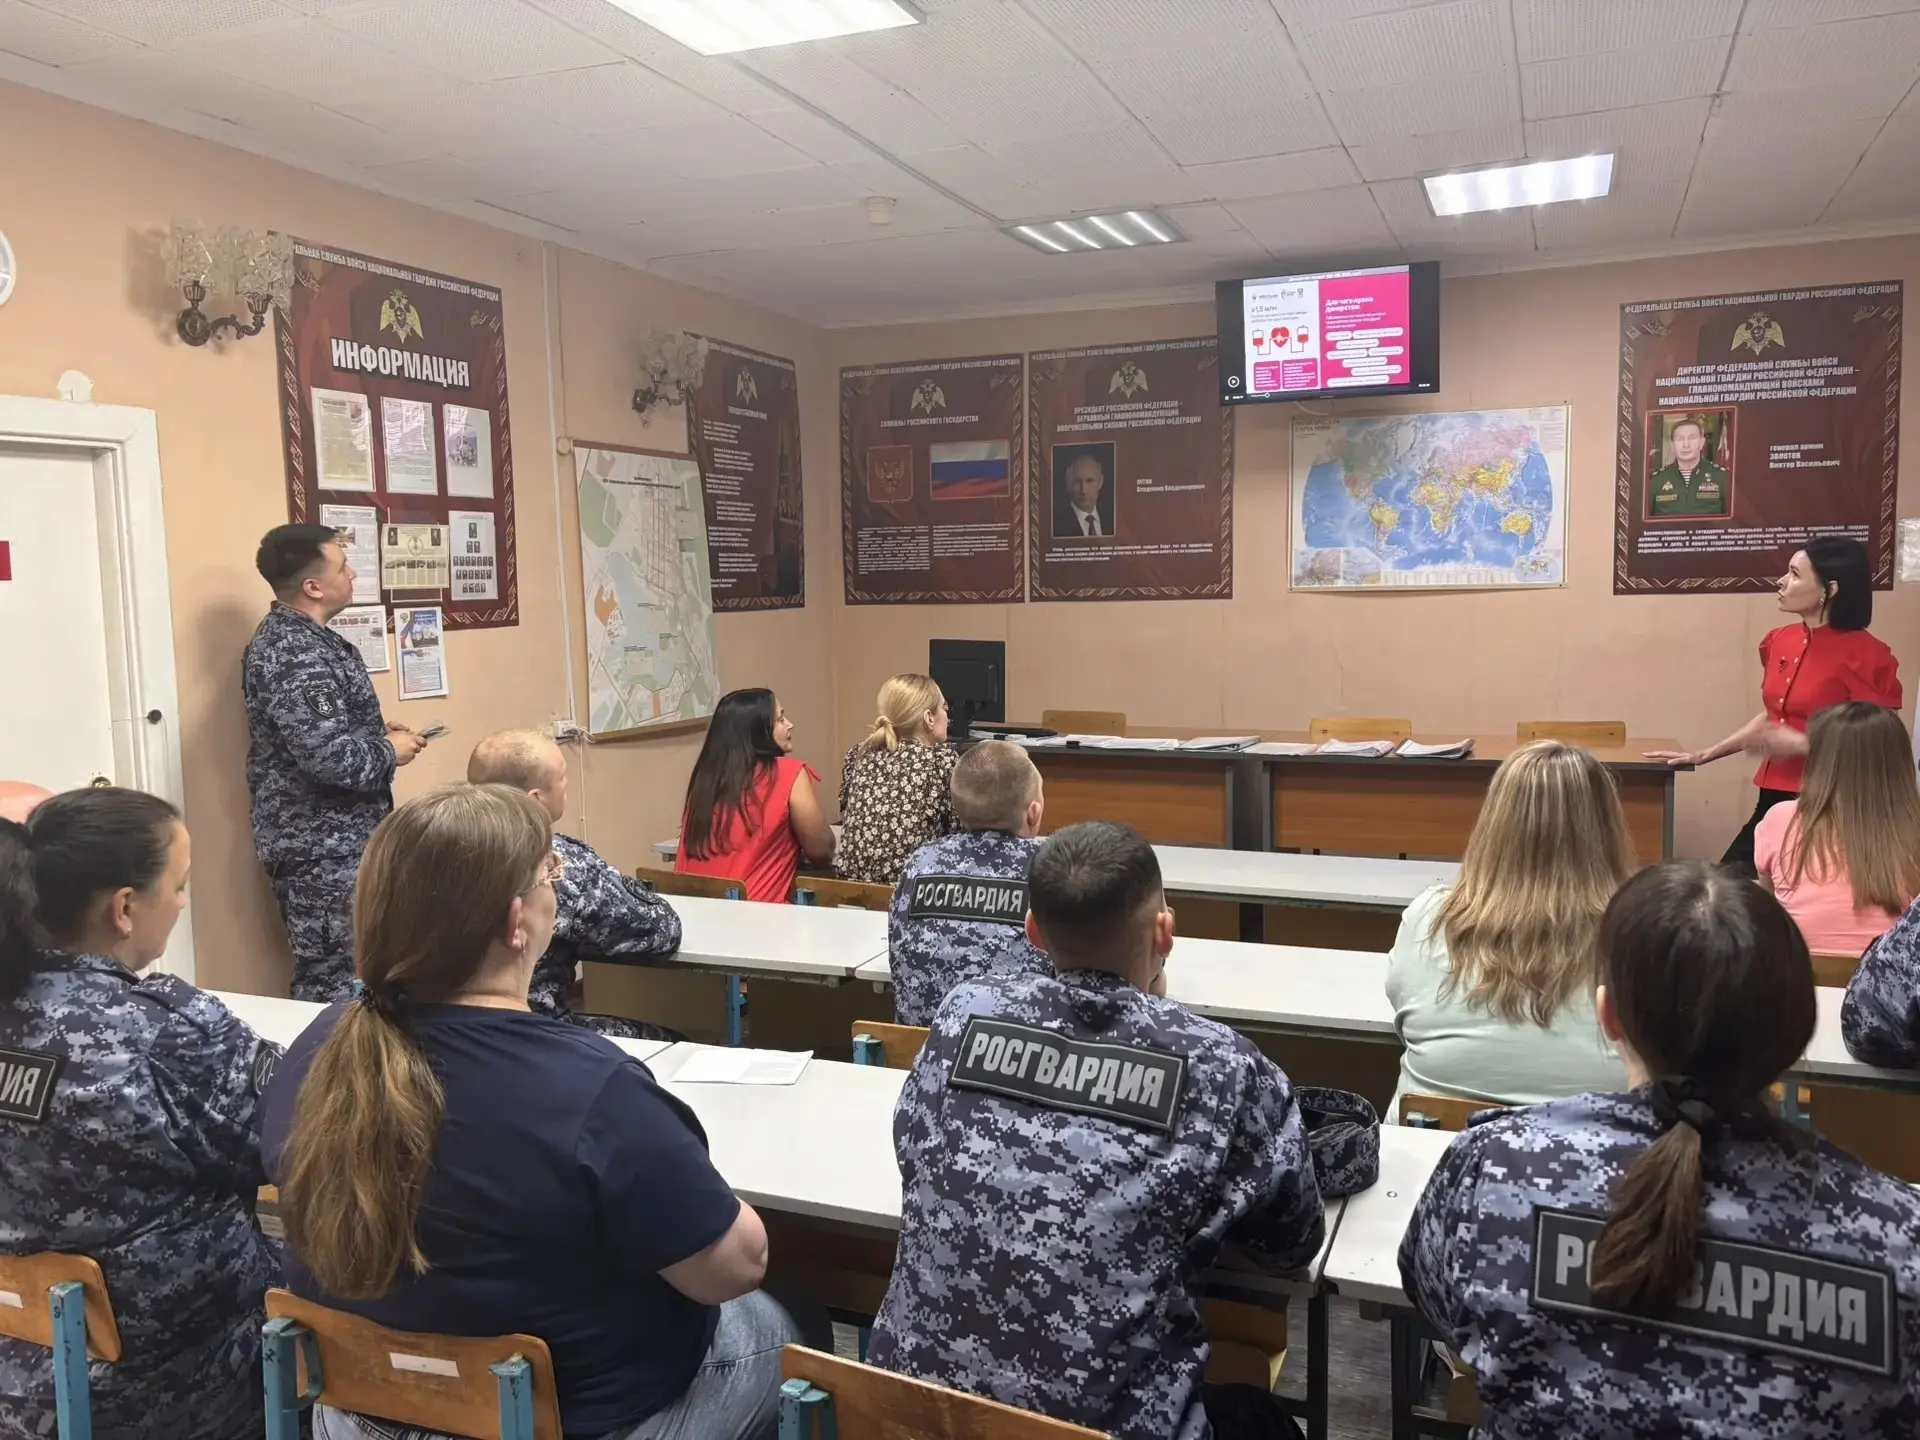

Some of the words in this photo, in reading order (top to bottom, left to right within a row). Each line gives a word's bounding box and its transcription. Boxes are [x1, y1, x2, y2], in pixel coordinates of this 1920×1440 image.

[1624, 302, 1673, 314] ФЕДЕРАЛЬНАЯ
[1673, 300, 1701, 310] СЛУЖБА
[1701, 298, 1724, 308] ВОЙСК
[1724, 293, 1779, 306] НАЦИОНАЛЬНОЙ
[1779, 291, 1810, 301] ГВАРДИИ
[1810, 286, 1856, 299] РОССИЙСКОЙ
[1856, 283, 1899, 296] ФЕДЕРАЦИИ
[331, 338, 469, 387] ИНФОРМАЦИЯ
[1676, 365, 1716, 377] ДИРЕКТОР
[1716, 360, 1774, 373] ФЕДЕРАЛЬНОЙ
[1775, 358, 1811, 369] СЛУЖБЫ
[1811, 356, 1839, 367] ВОЙСК
[1655, 373, 1716, 387] НАЦИОНАЛЬНОЙ
[1717, 372, 1753, 384] ГВАРДИИ
[1753, 368, 1805, 380] РОССИЙСКОЙ
[1805, 366, 1854, 377] ФЕДЕРАЦИИ
[1688, 379, 1781, 394] ГЛАВНОКОМАНДУЮЩИЙ
[1781, 377, 1825, 389] ВОЙСКАМИ
[1658, 393, 1719, 406] НАЦИОНАЛЬНОЙ
[1720, 391, 1756, 403] ГВАРДИИ
[1756, 388, 1808, 400] РОССИЙСКОЙ
[1809, 386, 1857, 398] ФЕДЕРАЦИИ
[1074, 405, 1106, 414] ПРЕЗИДЕНТ
[1106, 402, 1143, 412] РОССИЙСКОЙ
[1143, 400, 1179, 410] ФЕДЕРАЦИИ
[1077, 413, 1110, 423] ВЕРХОВНЫЙ
[1103, 420, 1127, 430] СИЛАМИ
[1127, 418, 1166, 428] РОССИЙСКОЙ
[1166, 415, 1202, 425] ФЕДЕРАЦИИ
[1769, 452, 1801, 461] ЗОЛОТОВ
[1796, 460, 1840, 469] Васильевич
[914, 883, 1024, 914] РОСГВАРДИЯ
[966, 1032, 1166, 1108] РОСГВАРДИЯ
